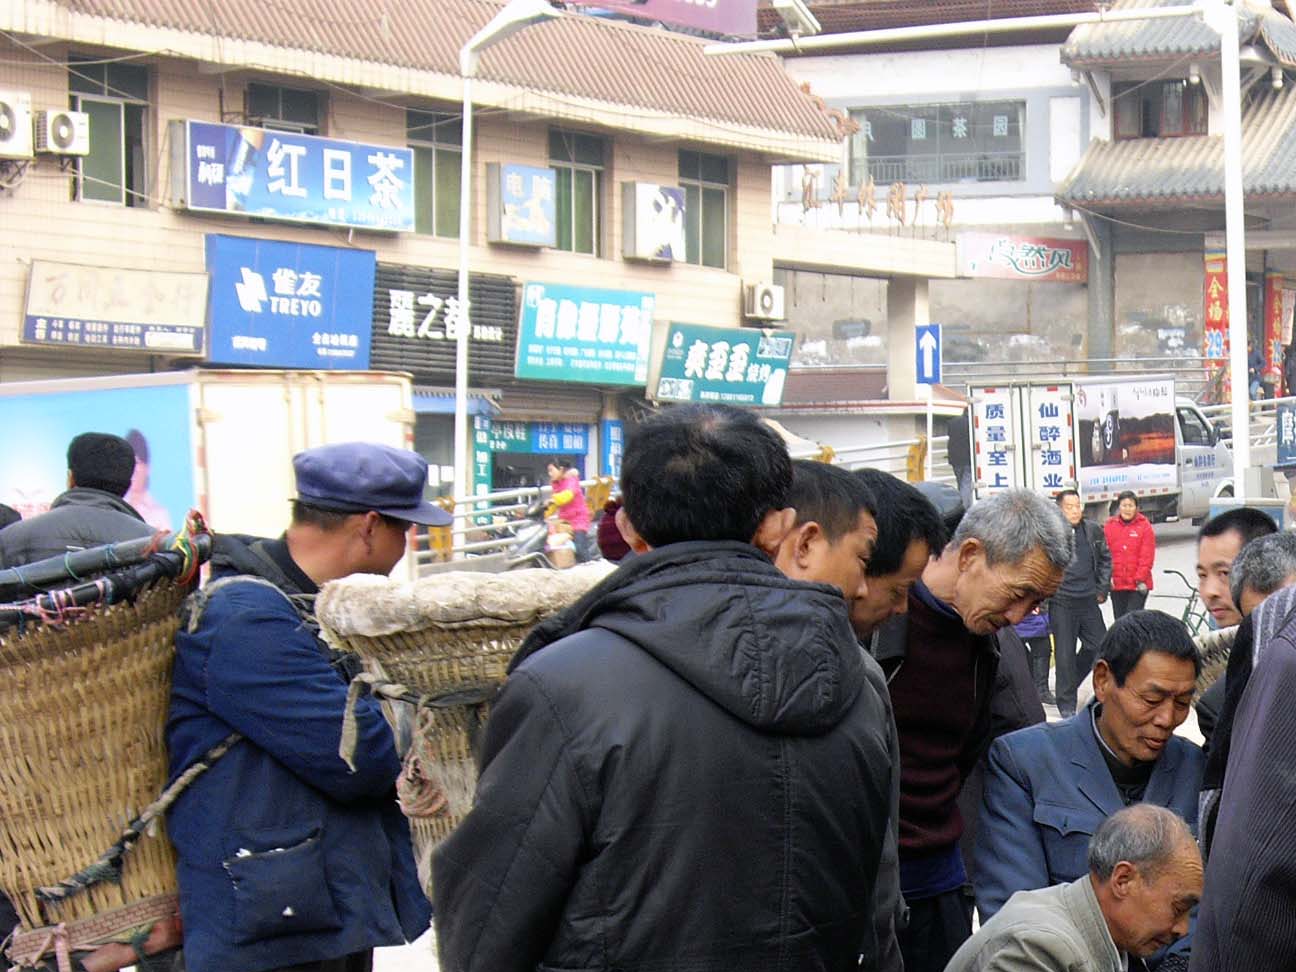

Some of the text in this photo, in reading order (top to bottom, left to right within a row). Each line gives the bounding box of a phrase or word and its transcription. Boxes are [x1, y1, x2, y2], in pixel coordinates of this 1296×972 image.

[267, 138, 405, 209] 红日茶
[270, 296, 322, 317] TREYO
[272, 267, 322, 297] 雀友
[985, 403, 1008, 488] 质量至上
[1038, 402, 1063, 488] 仙醉酒业
